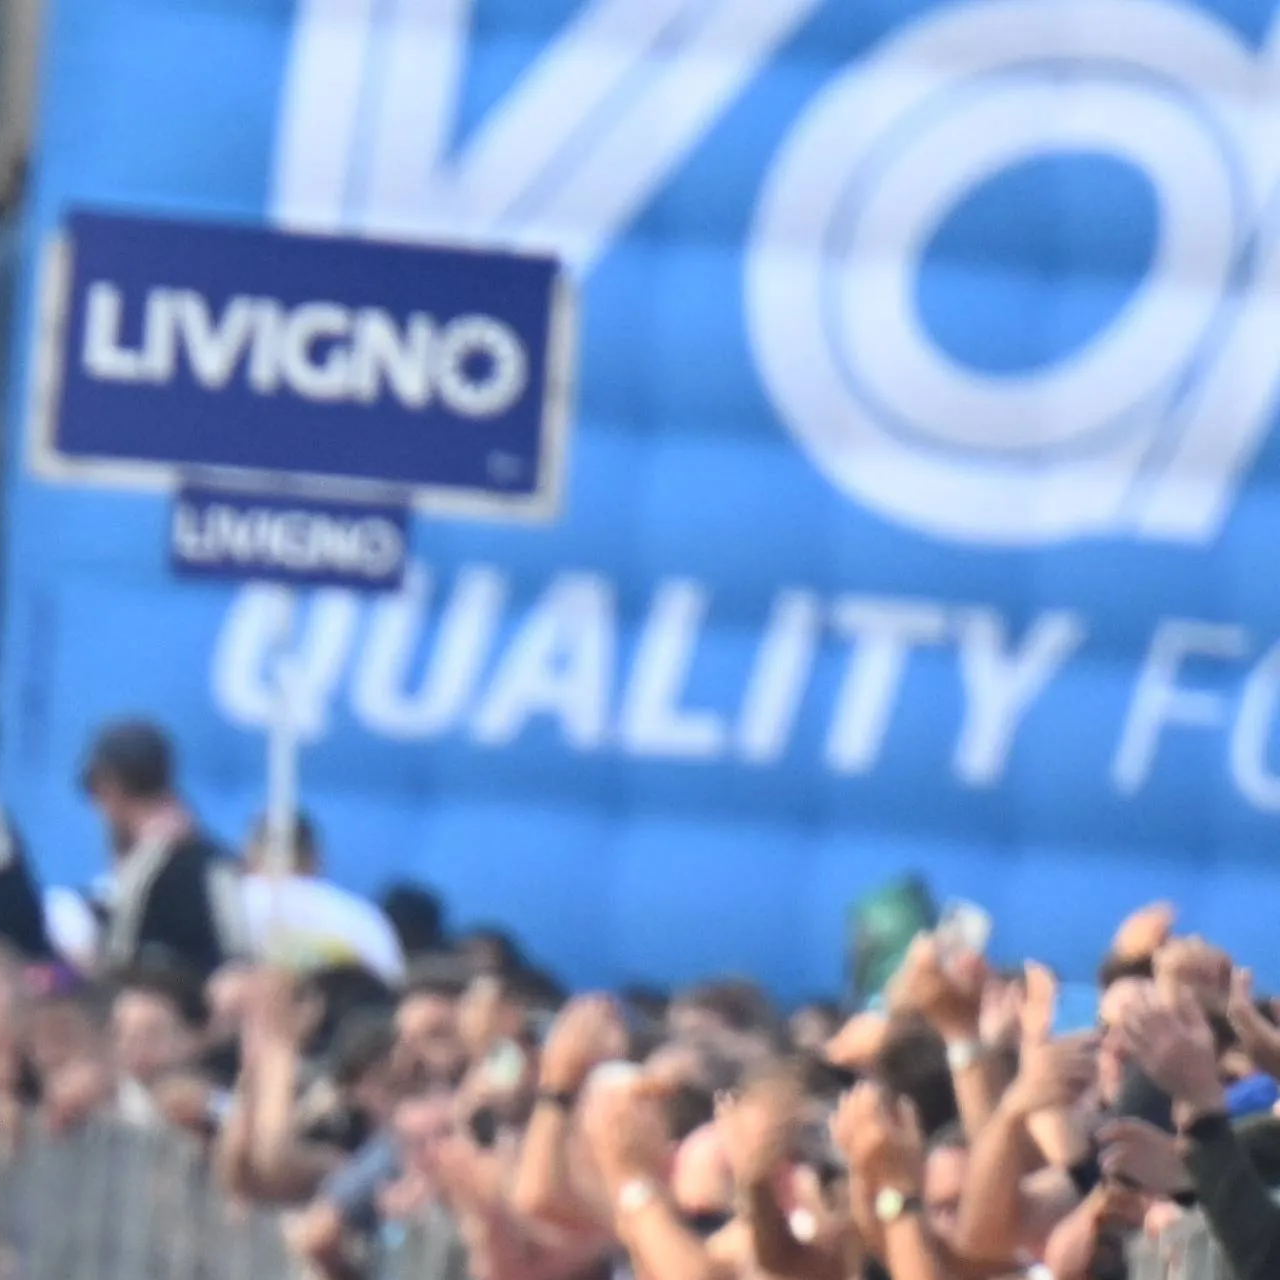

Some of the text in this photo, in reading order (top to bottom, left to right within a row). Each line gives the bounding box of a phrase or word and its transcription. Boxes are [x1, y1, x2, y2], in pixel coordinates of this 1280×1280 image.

[83, 280, 530, 420] LIVIGNO
[175, 502, 406, 580] LIVIGNO
[210, 566, 1088, 788] QUALITY
